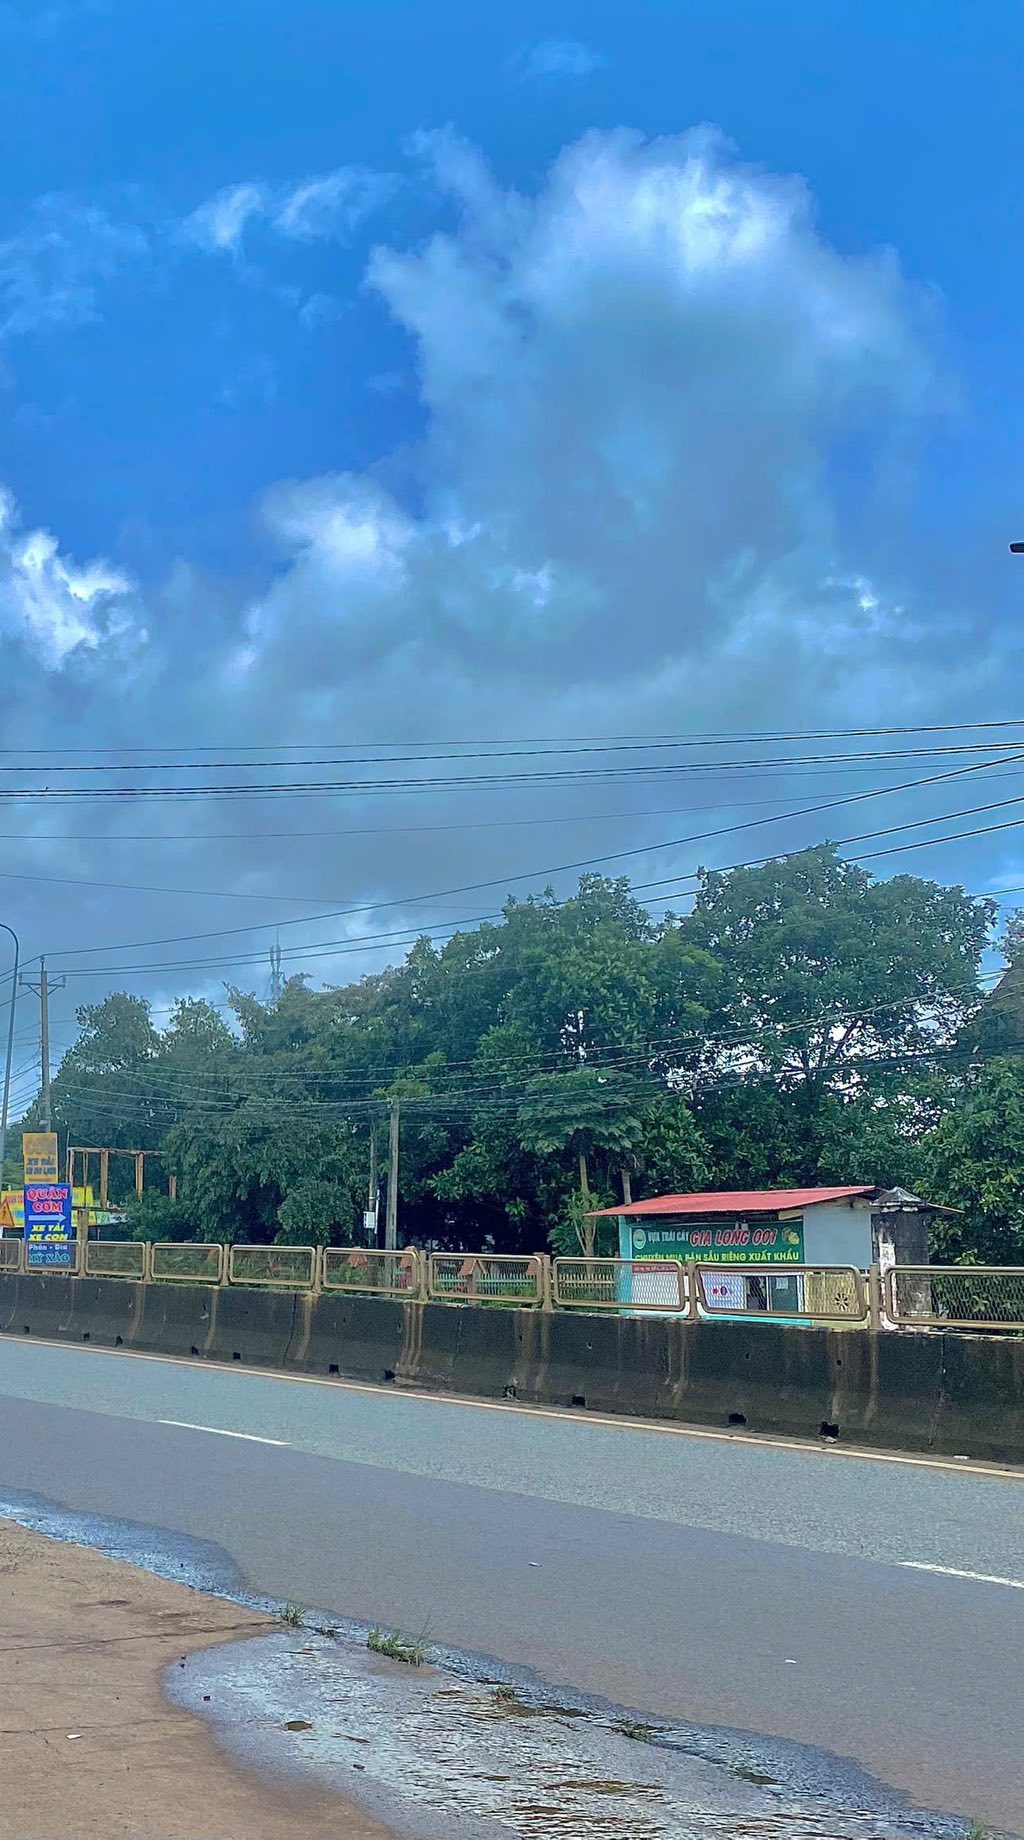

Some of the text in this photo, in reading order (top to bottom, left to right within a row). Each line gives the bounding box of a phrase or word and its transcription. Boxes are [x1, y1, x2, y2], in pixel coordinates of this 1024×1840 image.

[28, 1233, 43, 1241] XE
[690, 1230, 712, 1247] GIA
[721, 1250, 746, 1261] RIÊNG
[748, 1249, 773, 1261] XUẤT
